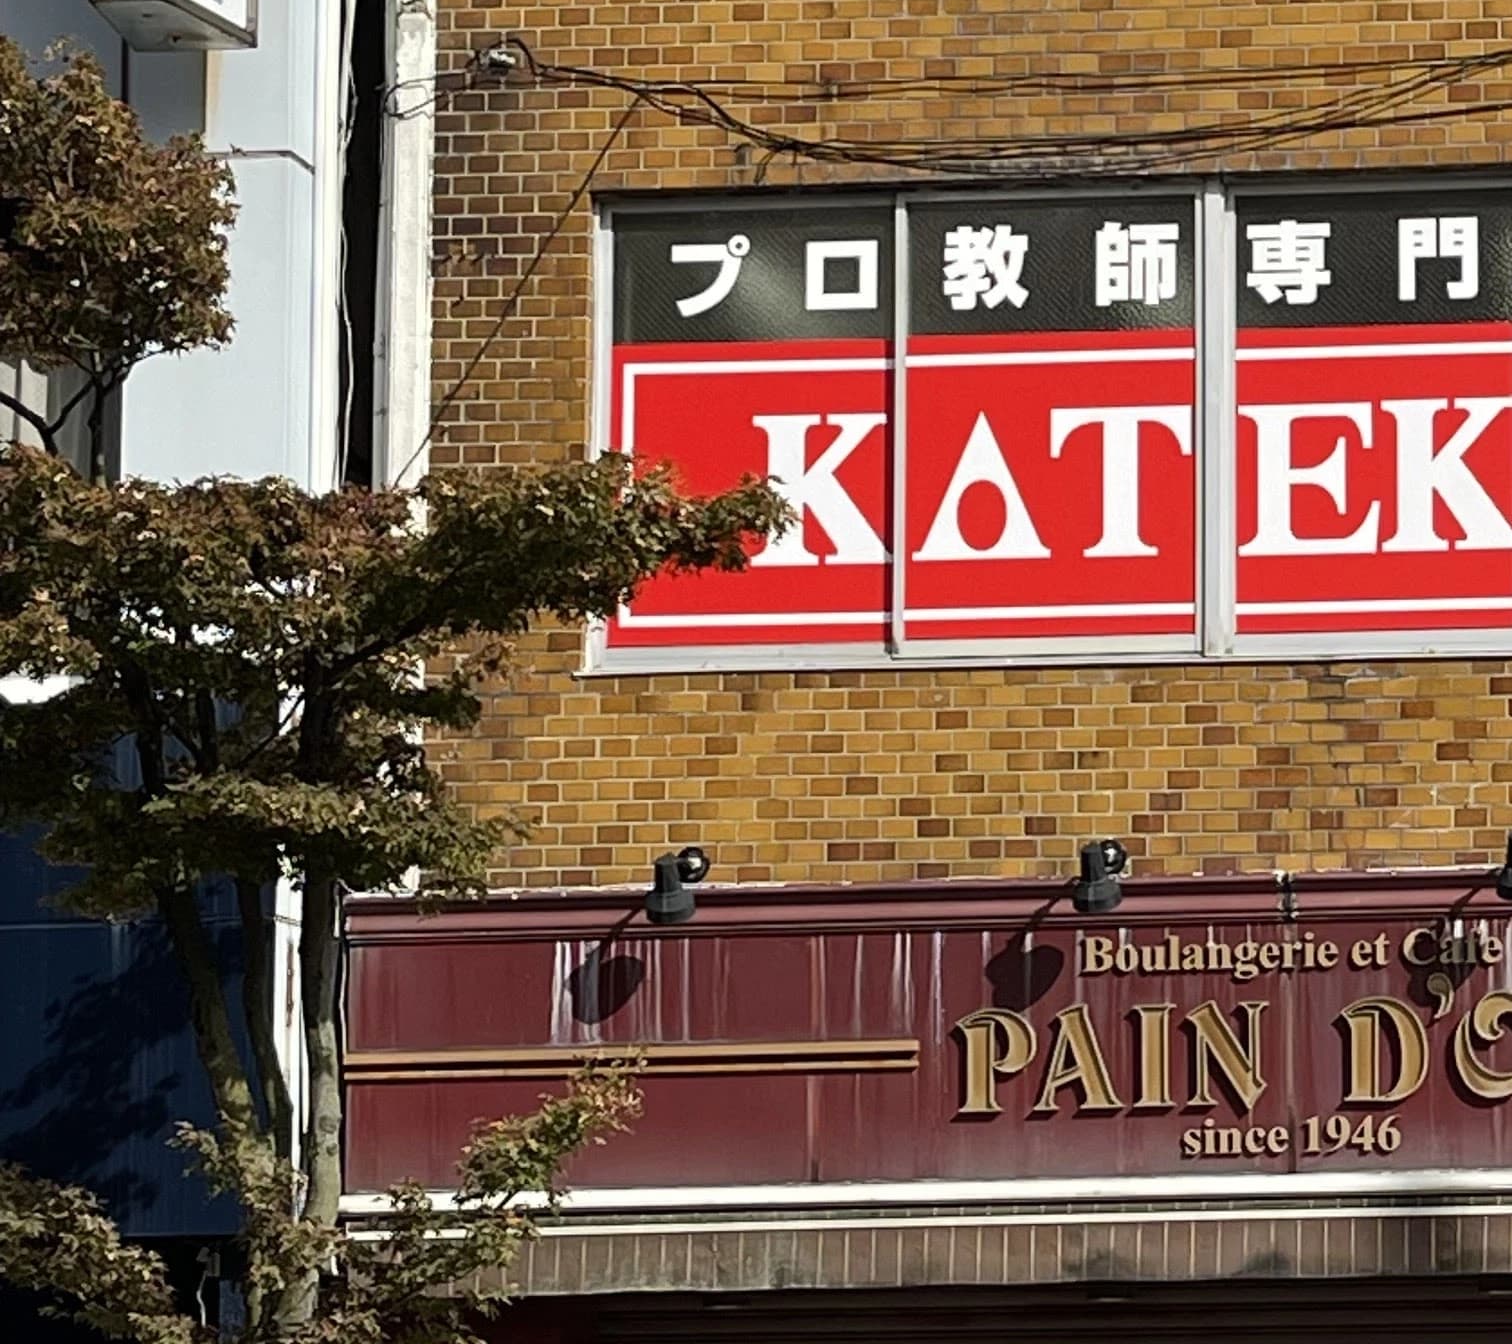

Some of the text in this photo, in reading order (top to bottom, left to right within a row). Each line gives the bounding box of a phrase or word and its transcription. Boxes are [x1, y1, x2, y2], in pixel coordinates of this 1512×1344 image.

[1083, 931, 1339, 978] Boulangerie
[1351, 931, 1391, 967] et
[956, 1000, 1269, 1113] PAIN
[1183, 1114, 1401, 1154] since 1946
